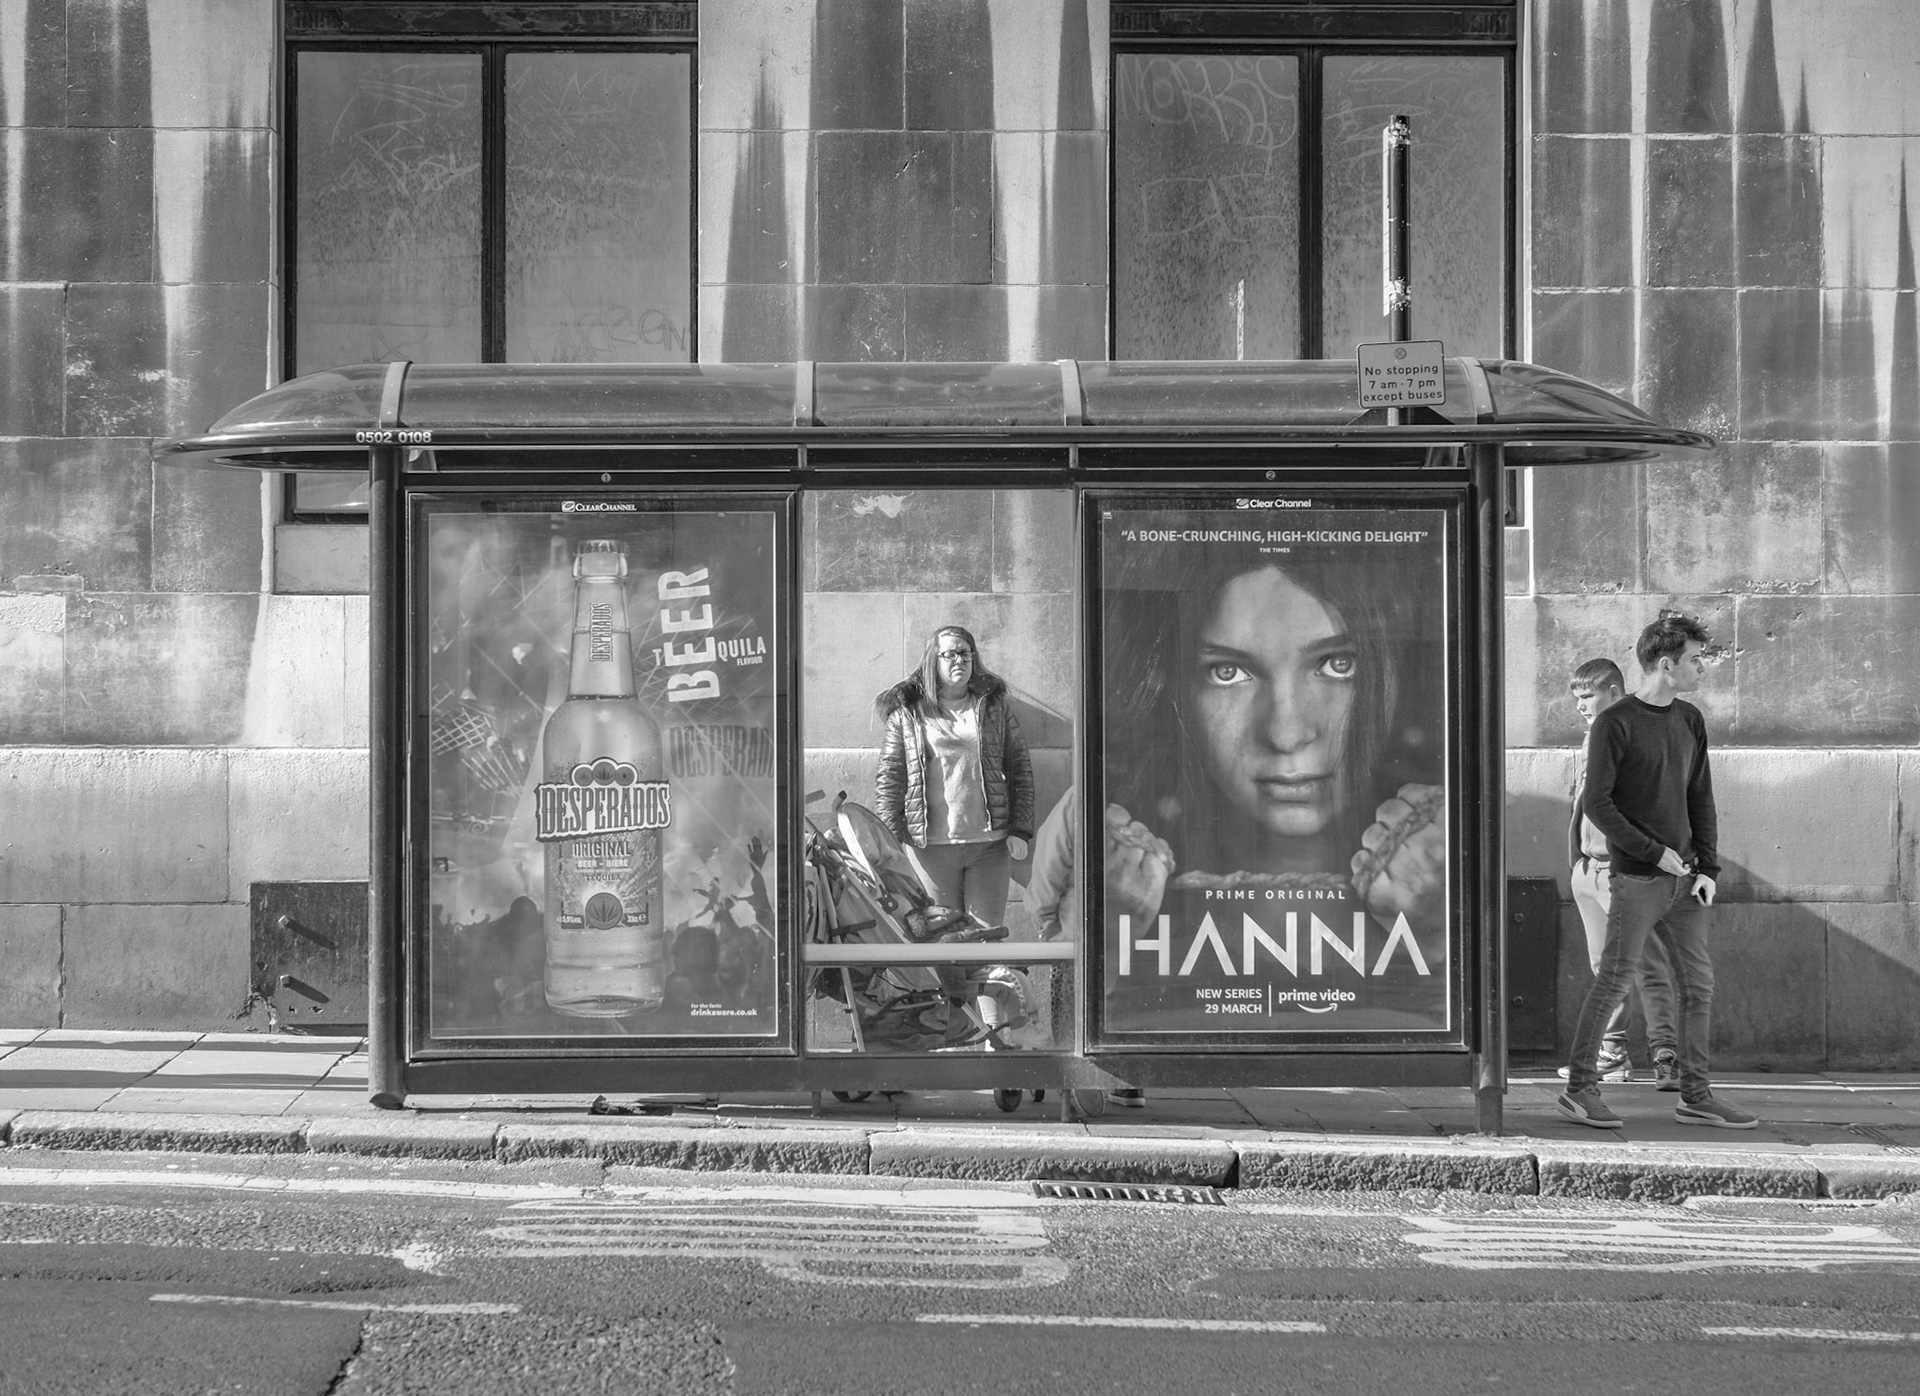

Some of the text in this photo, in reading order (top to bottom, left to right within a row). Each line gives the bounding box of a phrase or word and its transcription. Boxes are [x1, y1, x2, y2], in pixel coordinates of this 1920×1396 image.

[1364, 364, 1439, 376] No stopping
[1368, 380, 1376, 390] 7
[1380, 381, 1397, 389] am
[1406, 378, 1414, 388] 7
[1418, 379, 1436, 388] pm
[1363, 390, 1443, 402] except buses
[355, 431, 432, 444] 0502 0108
[1249, 498, 1311, 508] Clear Channel
[1139, 530, 1265, 544] BONE-CRUNCHING,
[1267, 530, 1362, 543] HIGH-KICKING
[590, 602, 612, 661] DESPERADOS
[657, 567, 721, 702] BEER
[736, 656, 764, 667] FLAVOUR
[540, 785, 670, 836] DESPERADOS
[572, 841, 631, 858] ORIGINAL
[577, 860, 597, 868] BEER
[1205, 890, 1346, 900] PRIME ORIGINAL
[1118, 910, 1431, 978] HANNA
[1195, 988, 1263, 999] NEW SERIES
[1278, 989, 1356, 1004] prime video
[690, 1008, 758, 1016] drinkaware.co.uk
[1204, 1003, 1263, 1014] 29 MARCH
